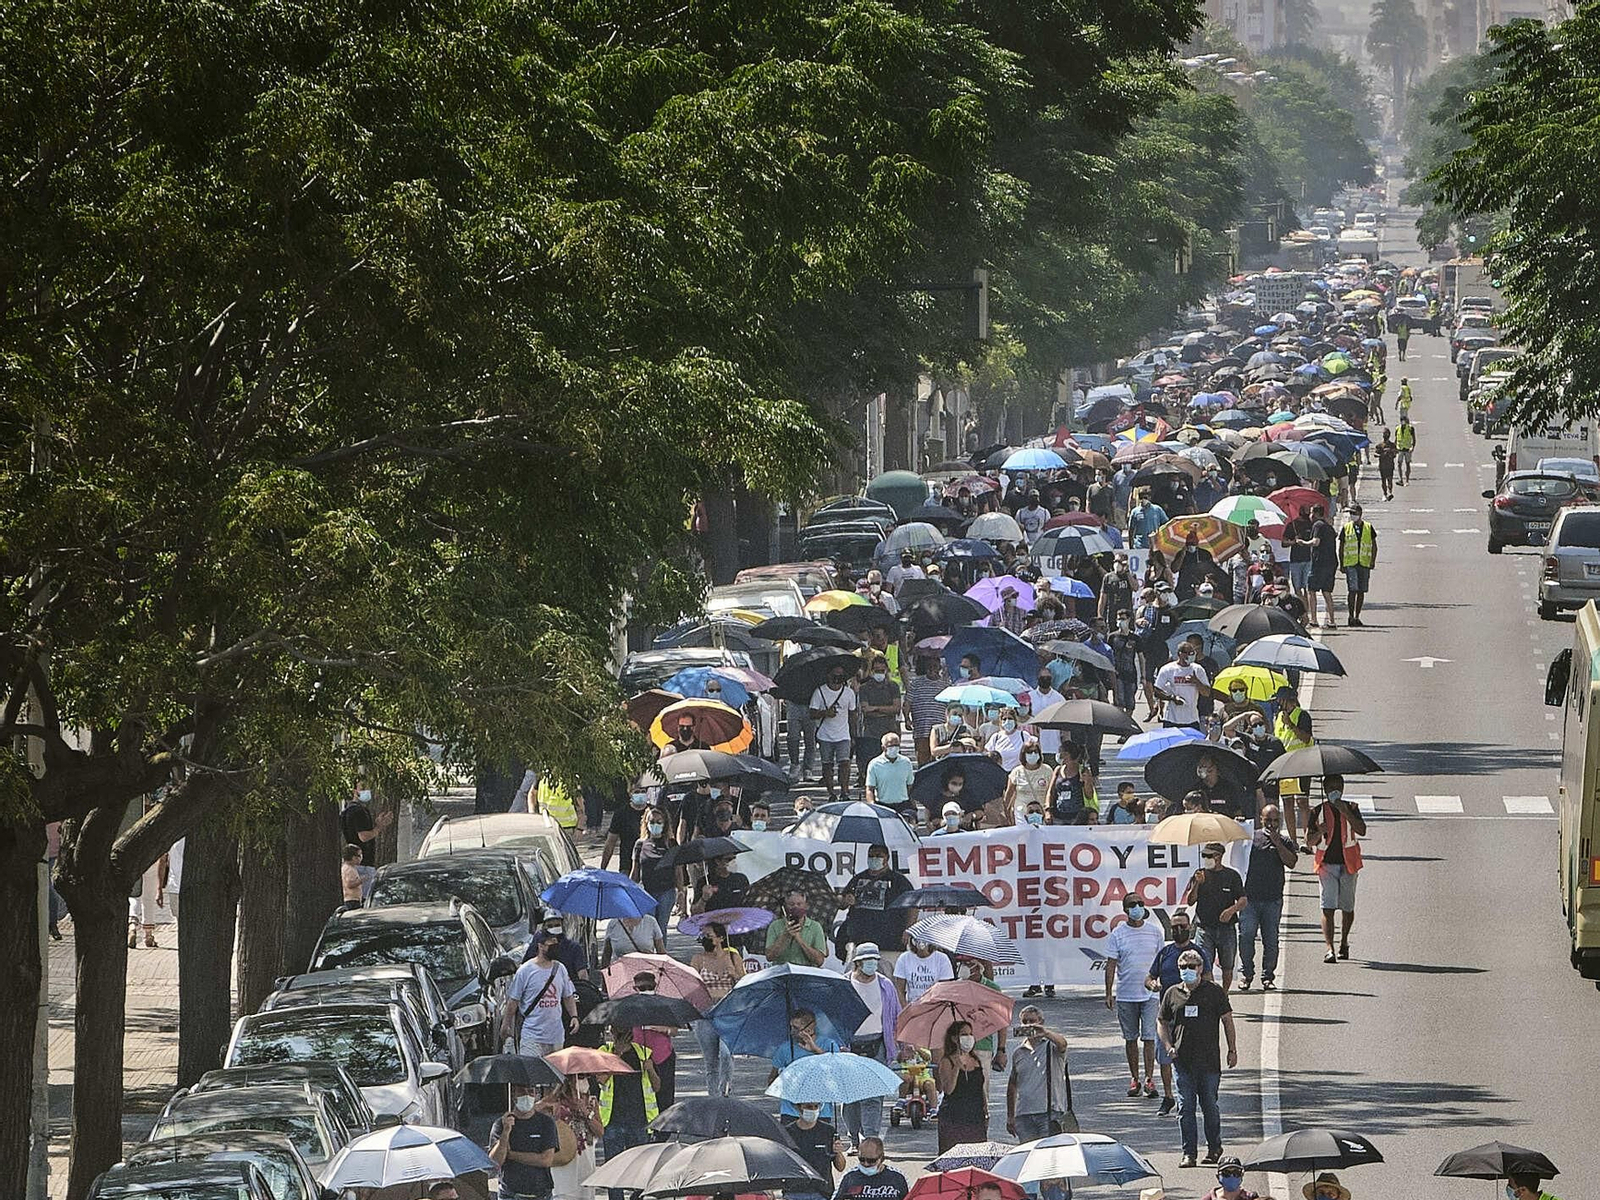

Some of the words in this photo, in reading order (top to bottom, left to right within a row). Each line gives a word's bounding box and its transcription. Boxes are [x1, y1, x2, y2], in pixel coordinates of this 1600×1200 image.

[785, 851, 853, 875] POR
[918, 843, 1101, 877] EMPLEO
[1110, 845, 1135, 869] Y
[1147, 844, 1190, 869] EL
